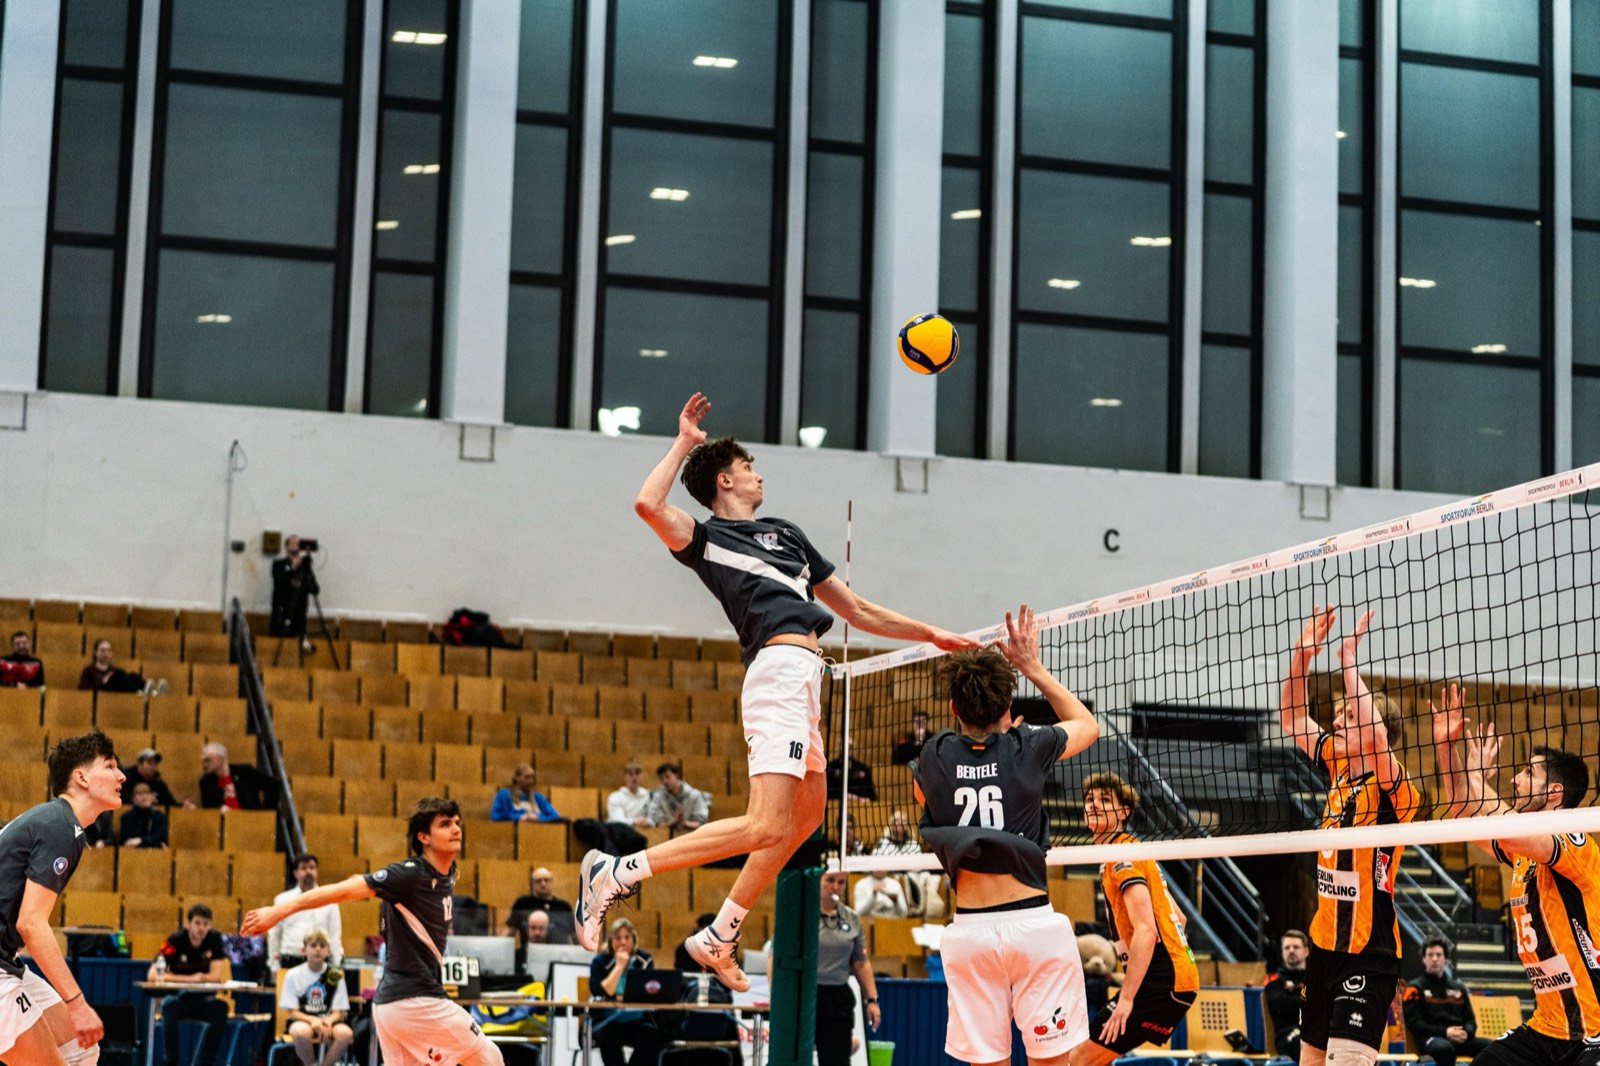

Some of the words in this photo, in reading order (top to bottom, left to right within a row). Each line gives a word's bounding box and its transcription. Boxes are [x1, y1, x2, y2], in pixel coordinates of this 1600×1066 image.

[1559, 478, 1575, 488] BERLIN
[1440, 506, 1475, 523] SPORTFORUM
[1476, 502, 1494, 514] BERLIN
[1104, 528, 1120, 553] C
[1293, 548, 1322, 562] SPORTFORUM
[1322, 544, 1338, 554] BERLIN
[789, 740, 803, 760] 16
[956, 763, 998, 779] BERTELE
[954, 785, 1005, 831] 26
[1317, 868, 1334, 883] ERLIN
[1318, 881, 1357, 897] CYCLING
[1514, 913, 1538, 954] 15
[443, 962, 464, 981] 16
[15, 992, 32, 1014] 21
